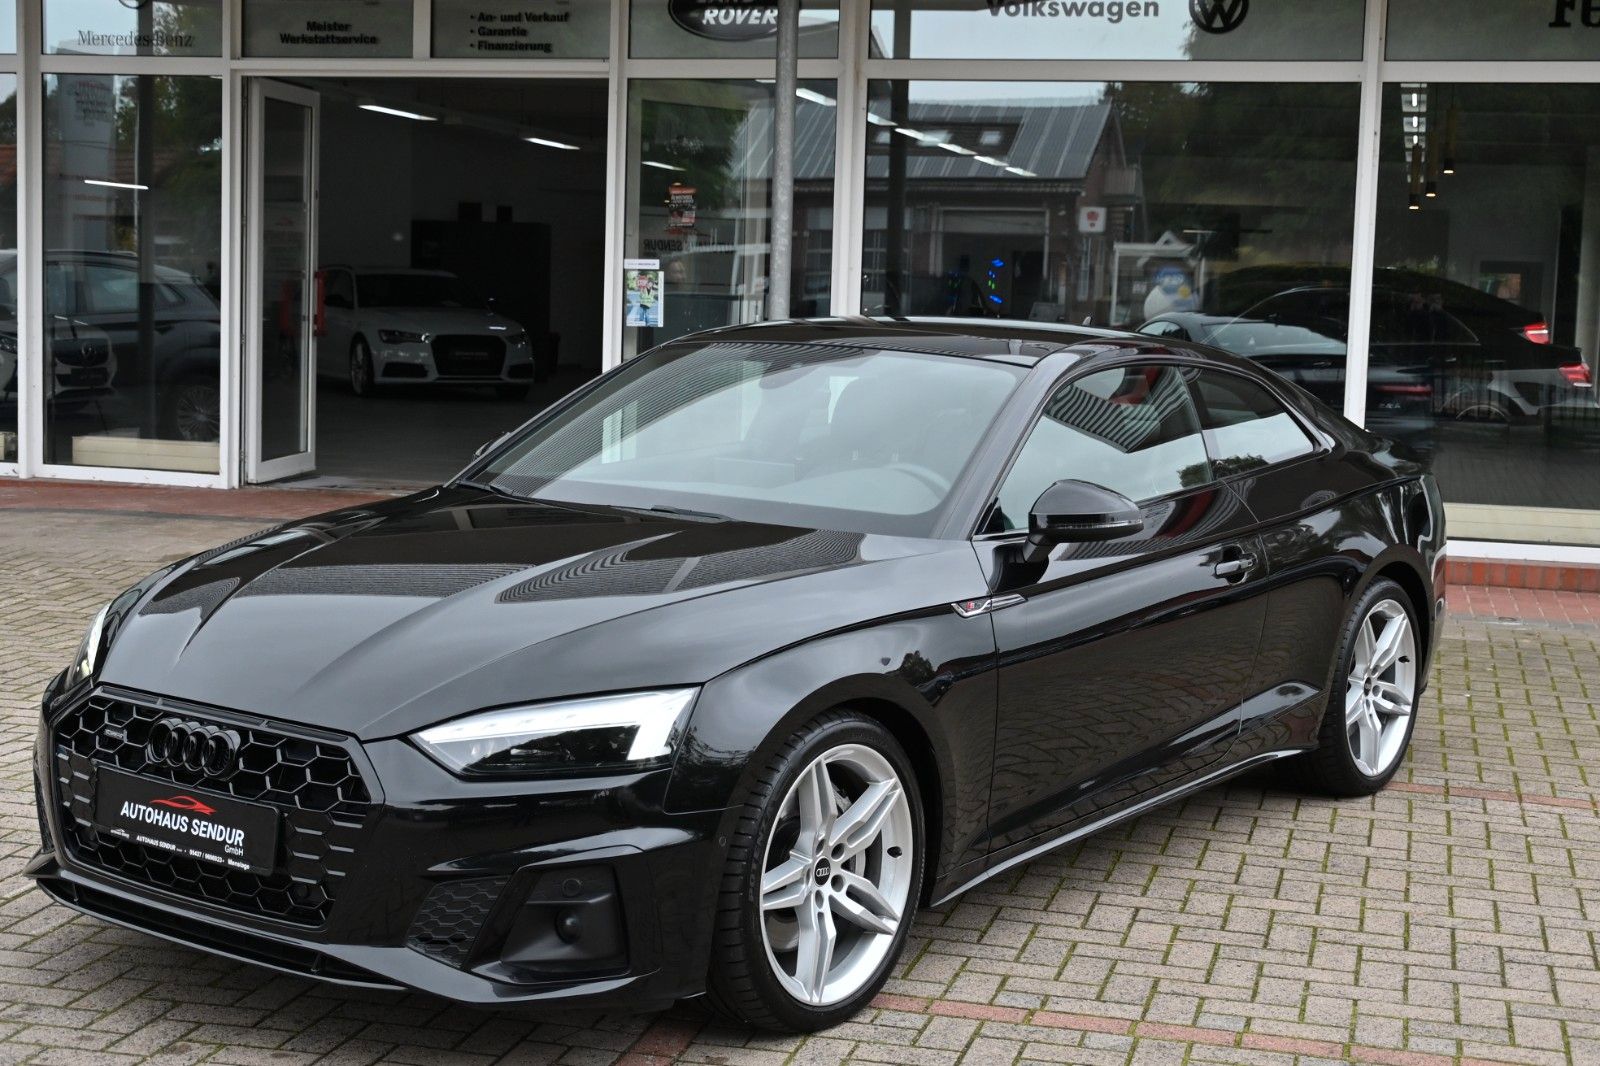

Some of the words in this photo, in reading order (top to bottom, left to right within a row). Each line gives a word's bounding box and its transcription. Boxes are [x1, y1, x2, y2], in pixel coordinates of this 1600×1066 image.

[500, 12, 522, 22] und
[525, 12, 570, 22] Verkauf
[702, 8, 779, 25] ROVER
[987, 0, 1159, 23] Volkswagen
[306, 21, 352, 32] Meister
[478, 27, 528, 36] Garantie
[279, 32, 379, 45] Werkstattservice
[478, 41, 552, 53] Finanzierung
[120, 801, 189, 832] AUTOHAUS
[190, 818, 245, 847] SENDUR
[224, 844, 244, 857] GmbH
